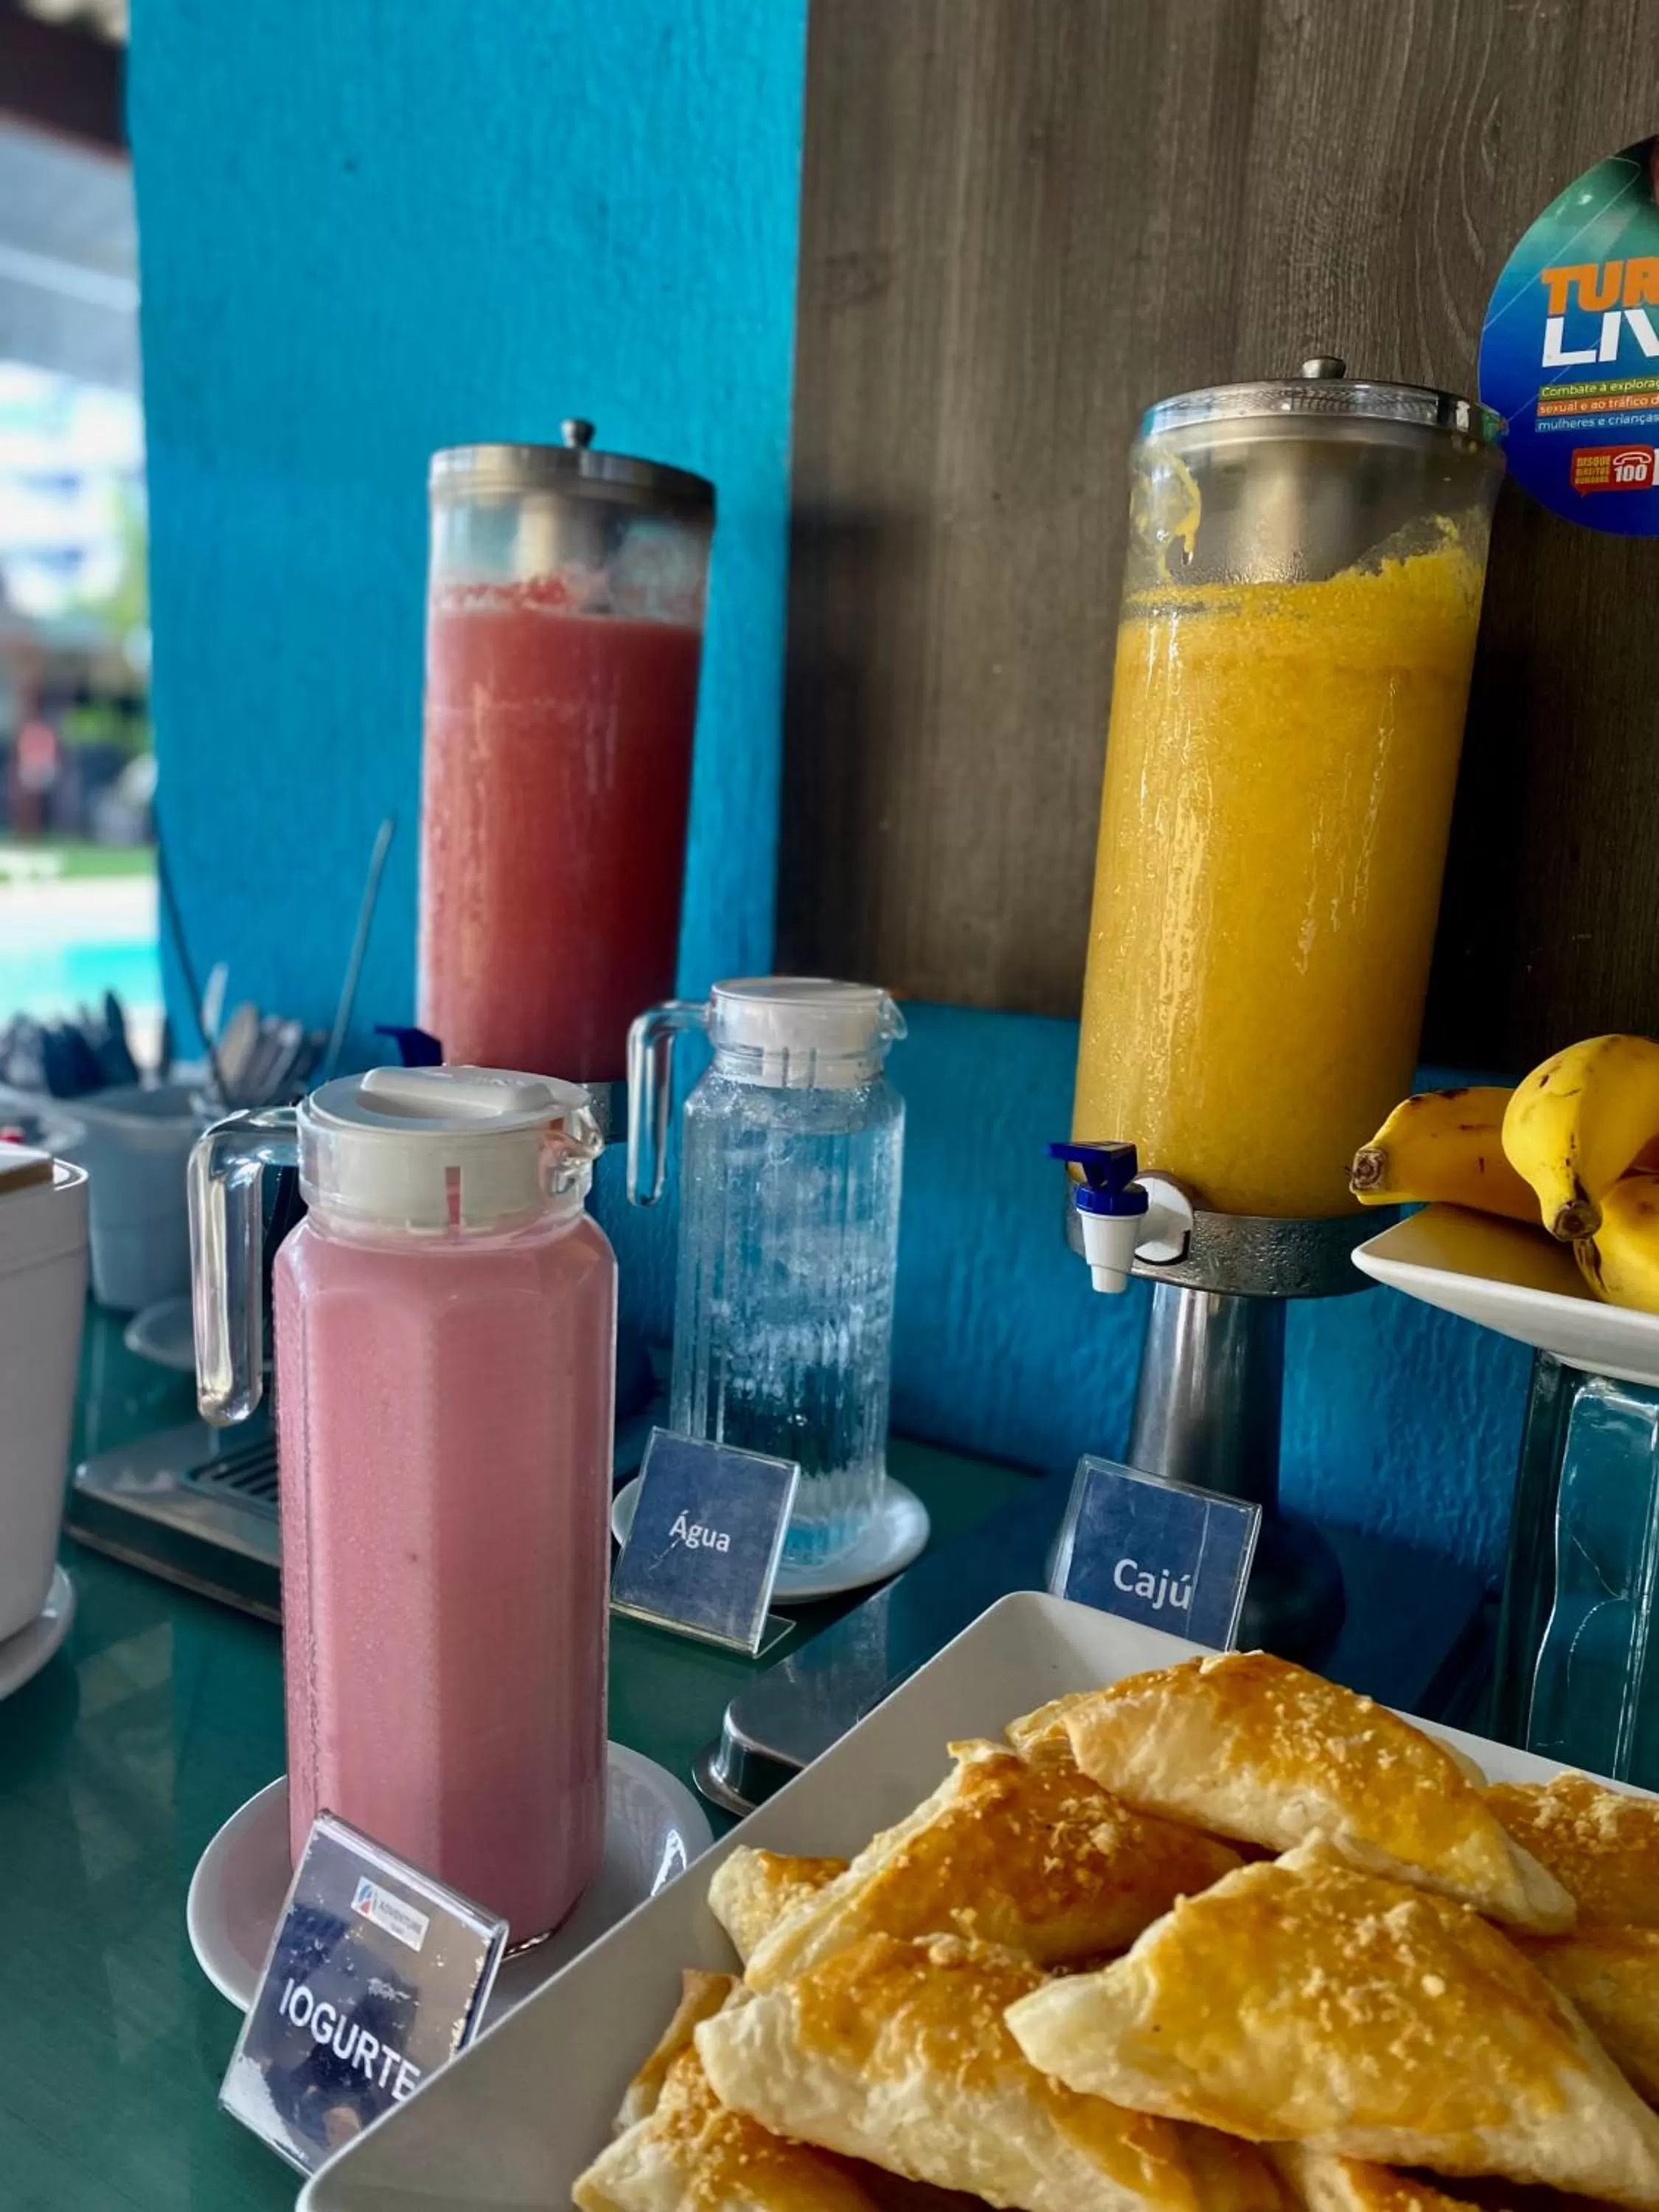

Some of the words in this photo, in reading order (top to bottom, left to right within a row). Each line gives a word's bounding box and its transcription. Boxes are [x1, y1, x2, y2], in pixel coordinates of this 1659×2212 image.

[1541, 257, 1659, 316] TUR
[1542, 383, 1596, 397] Combate
[1539, 400, 1577, 414] sexual
[1590, 400, 1605, 410] ao
[1538, 417, 1594, 431] mulheres
[1613, 464, 1648, 483] 100
[669, 1509, 731, 1552] Água
[1113, 1557, 1192, 1610] Cajú
[279, 1978, 422, 2102] IOGURTE
